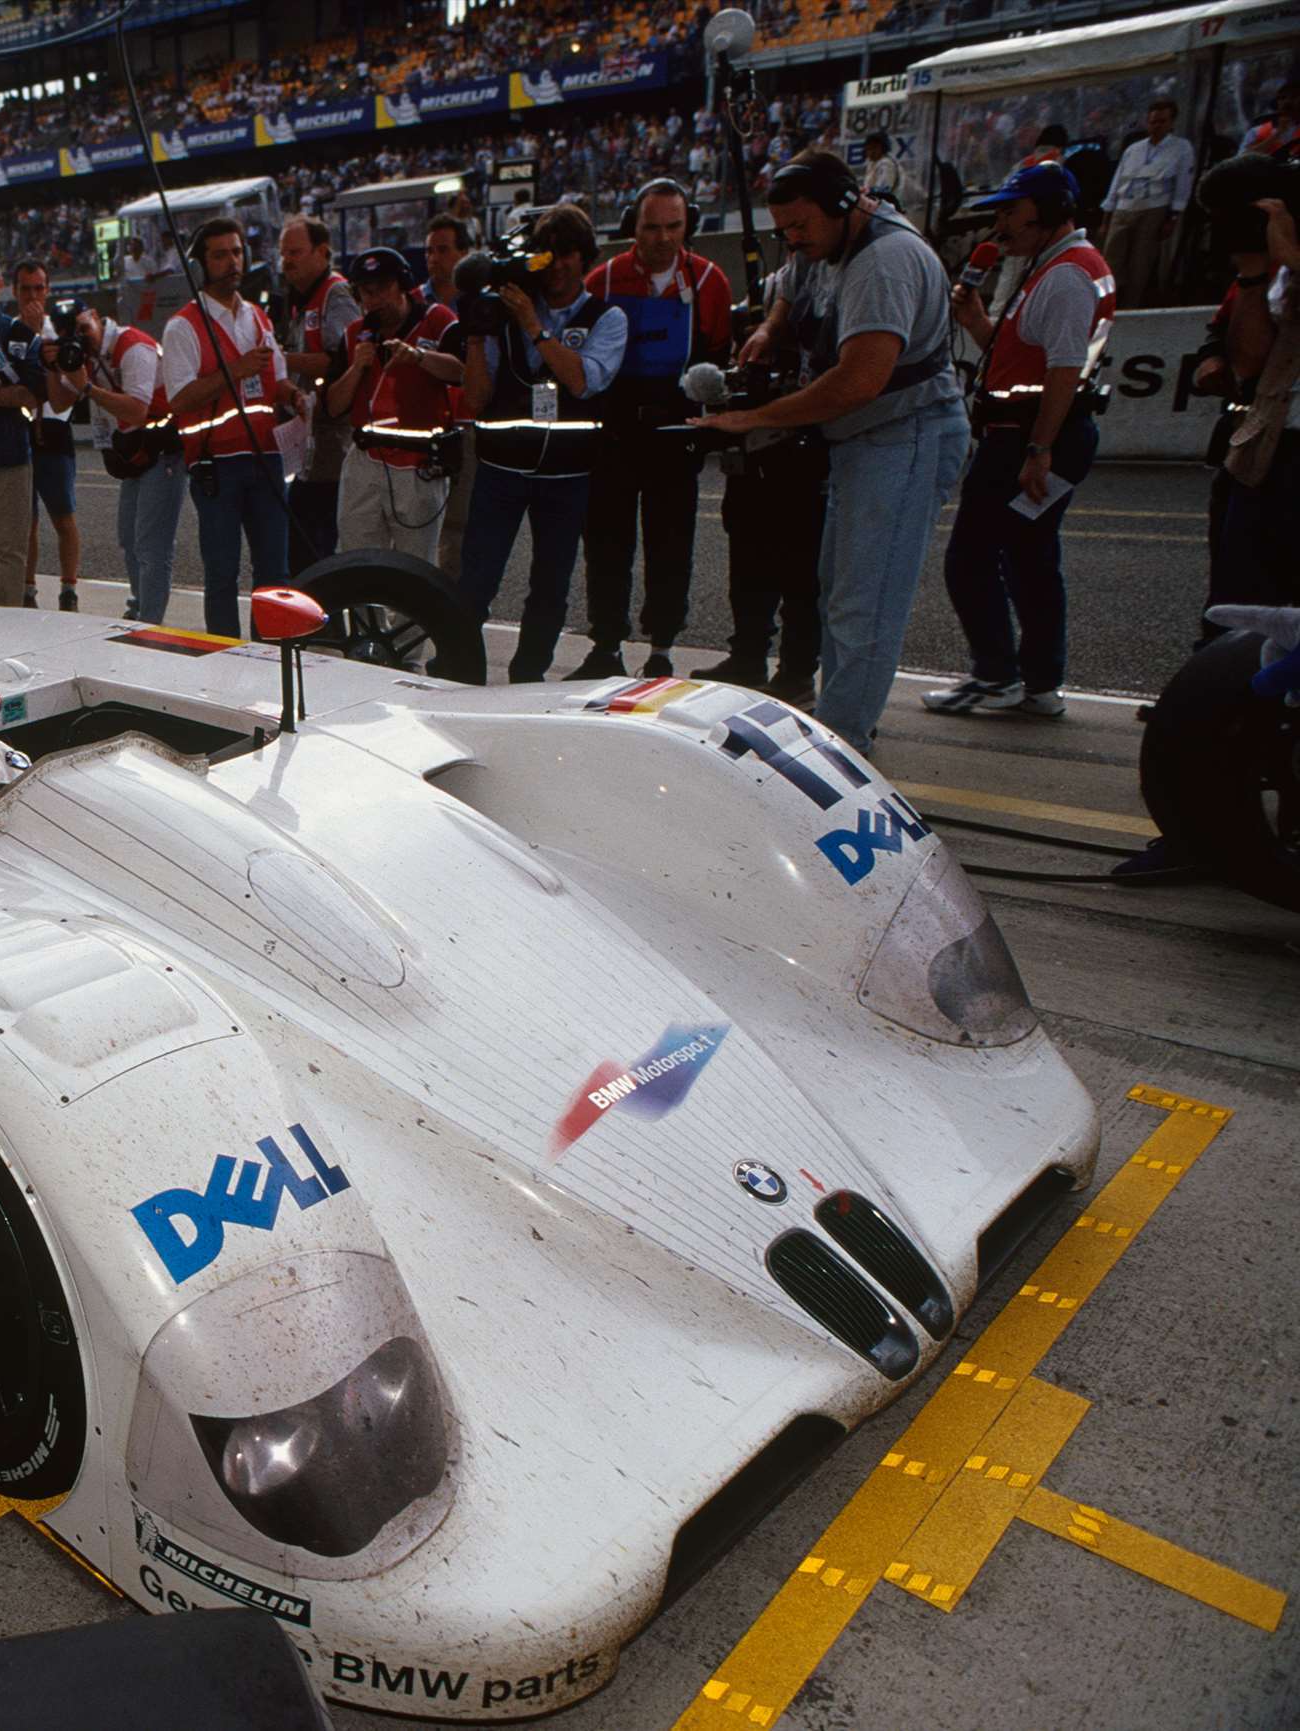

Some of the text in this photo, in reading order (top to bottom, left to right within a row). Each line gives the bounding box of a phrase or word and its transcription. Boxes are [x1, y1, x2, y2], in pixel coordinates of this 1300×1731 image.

[562, 63, 654, 89] MICN
[913, 69, 932, 86] 15
[421, 86, 499, 110] MICHELIN
[294, 108, 364, 130] MICHELIN
[187, 127, 248, 146] MICHELIN
[847, 136, 917, 165] BX
[814, 792, 932, 887] DELL
[588, 1033, 716, 1110] BMW Motorsport
[130, 1122, 351, 1285] DELL
[164, 1543, 304, 1618] MICHELIN
[332, 1650, 600, 1708] BMW parts
